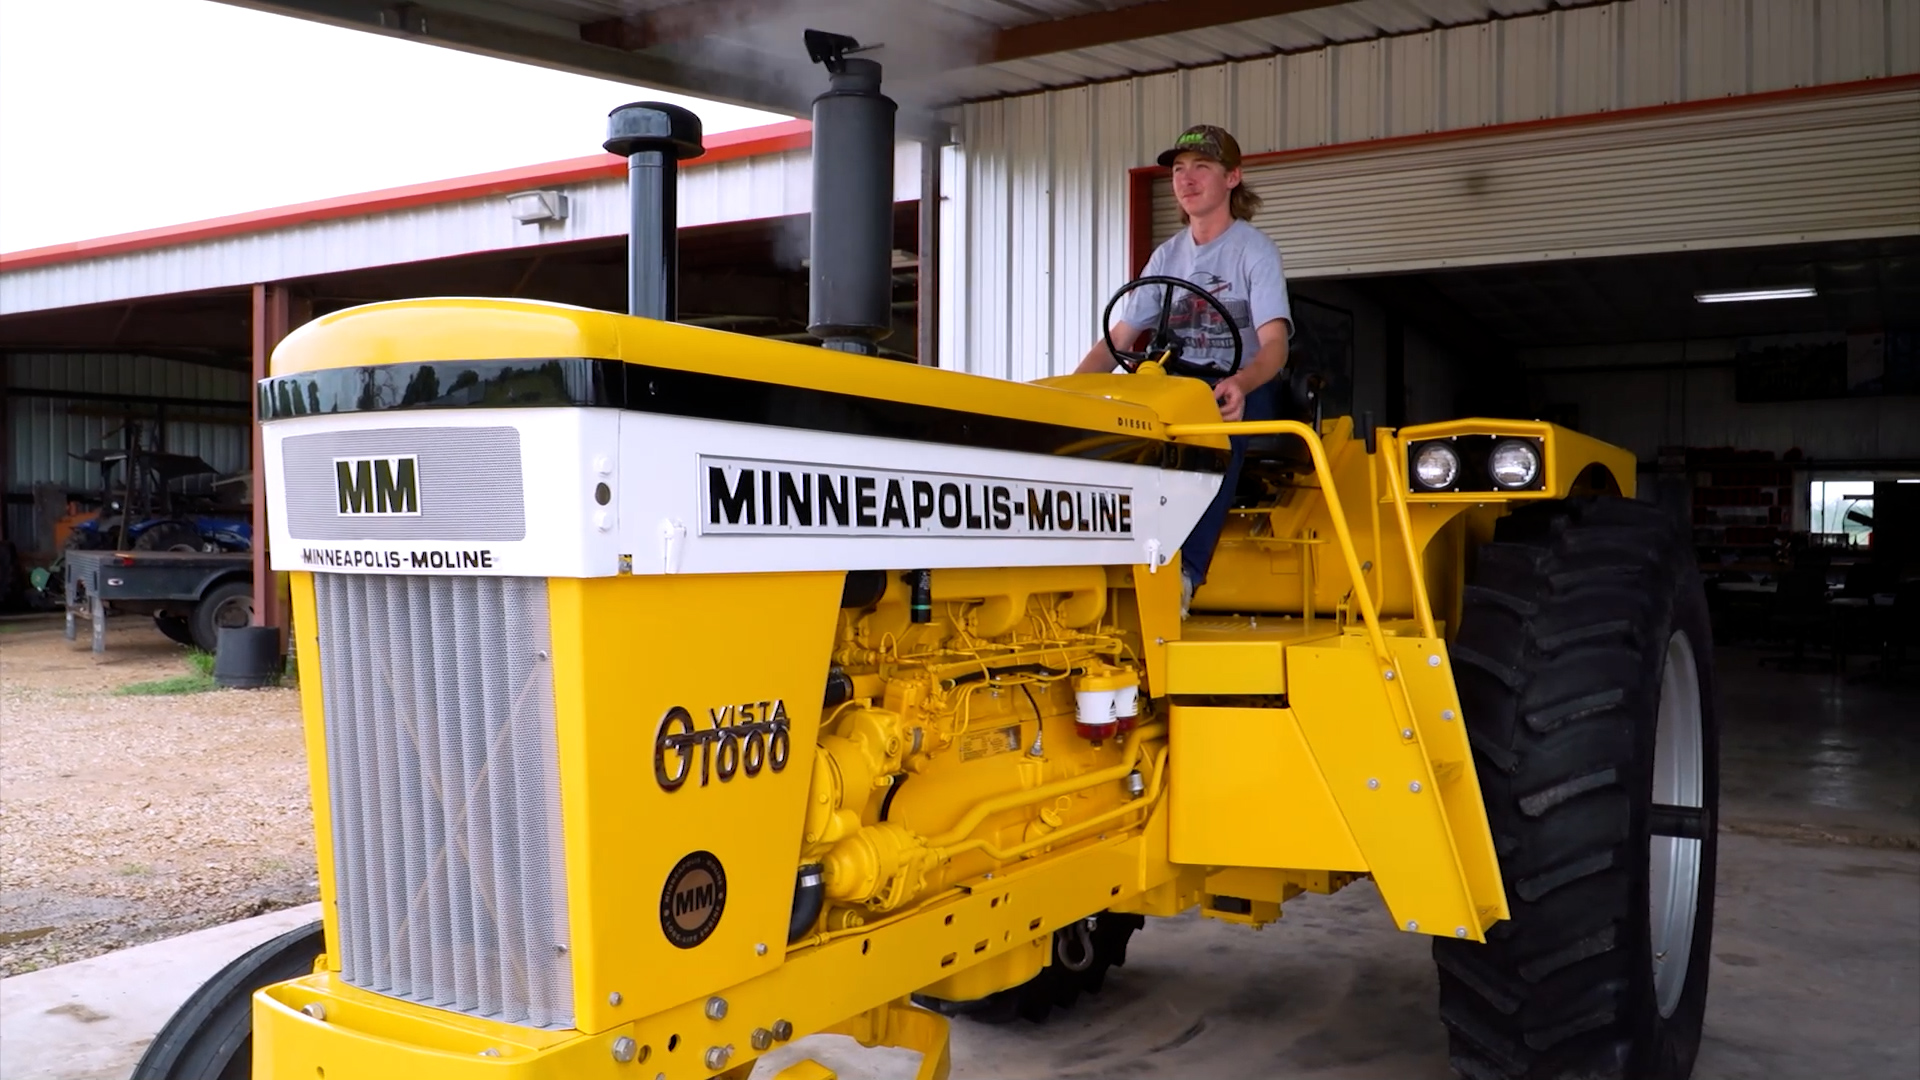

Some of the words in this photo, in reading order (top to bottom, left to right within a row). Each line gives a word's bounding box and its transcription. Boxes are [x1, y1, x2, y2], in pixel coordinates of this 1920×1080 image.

[1118, 417, 1152, 431] DIESEL
[336, 458, 418, 513] MM
[708, 466, 1132, 533] MINNEAPOLIS-MOLINE
[303, 548, 493, 569] MINNEAPOLIS-MOLINE
[708, 699, 789, 730] VISTA
[676, 883, 713, 917] MM
